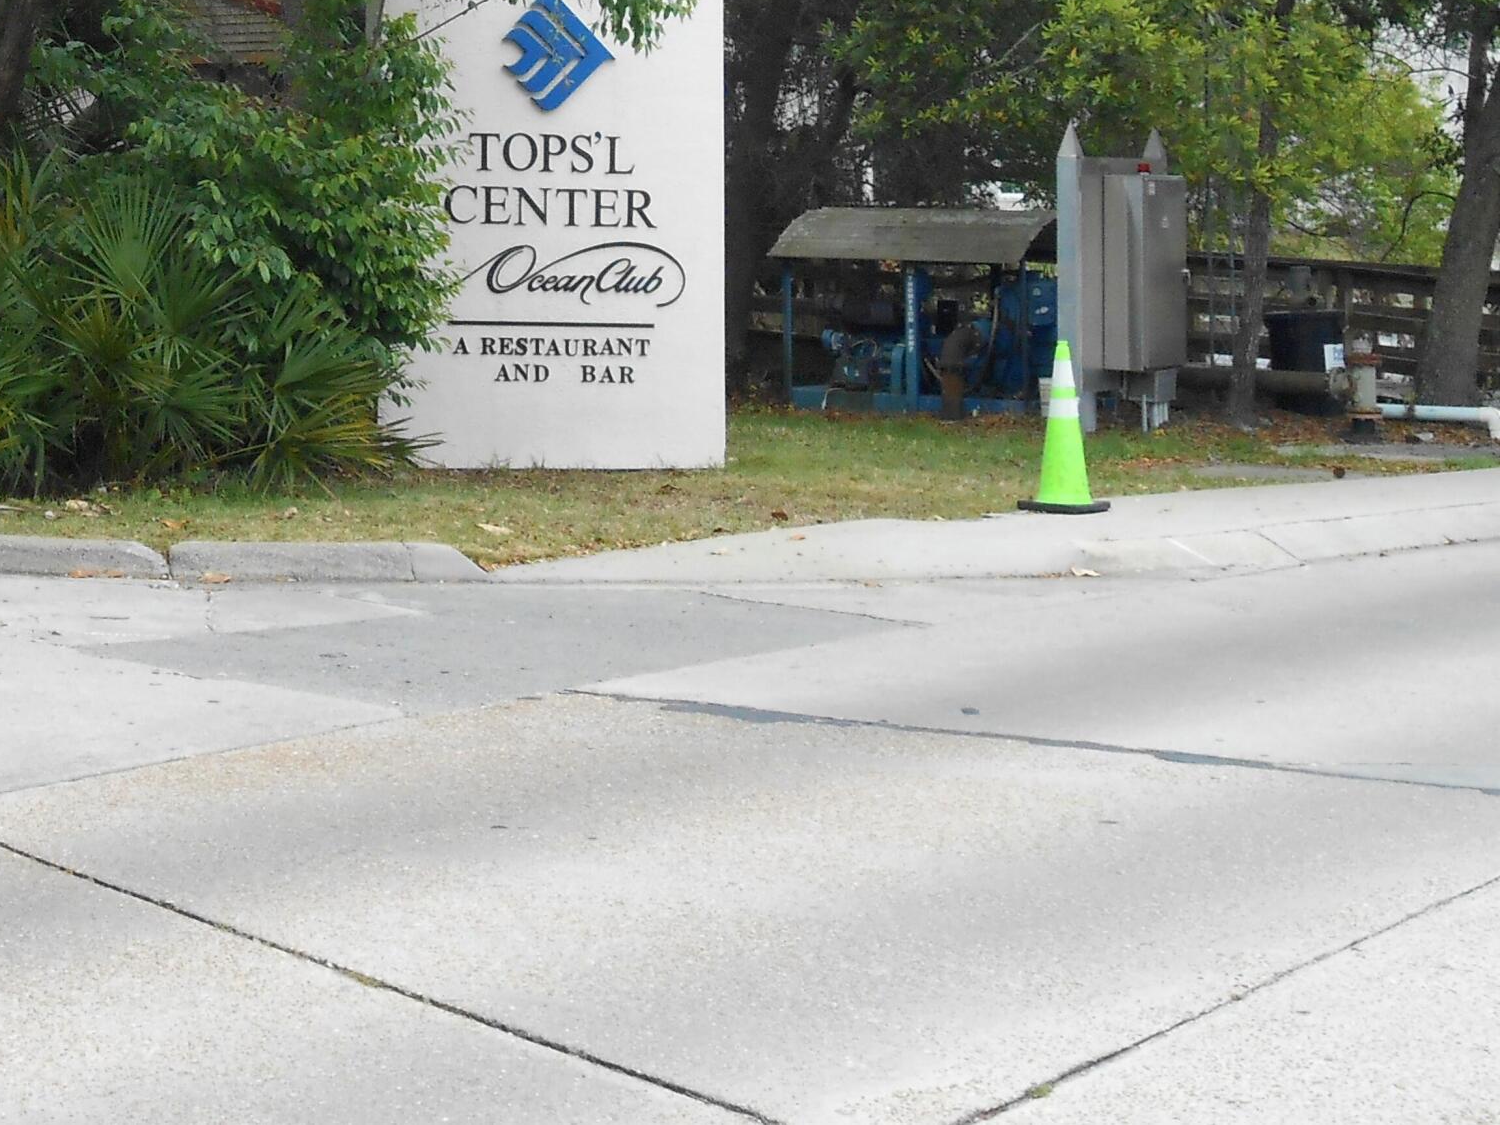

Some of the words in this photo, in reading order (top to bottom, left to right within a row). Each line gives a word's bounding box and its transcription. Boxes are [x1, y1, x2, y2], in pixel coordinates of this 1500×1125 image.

[469, 131, 635, 175] TOPS'L
[444, 185, 658, 229] CENTER
[452, 336, 471, 355] A
[480, 336, 651, 357] RESTAURANT
[494, 363, 550, 383] AND
[581, 364, 635, 384] BAR
